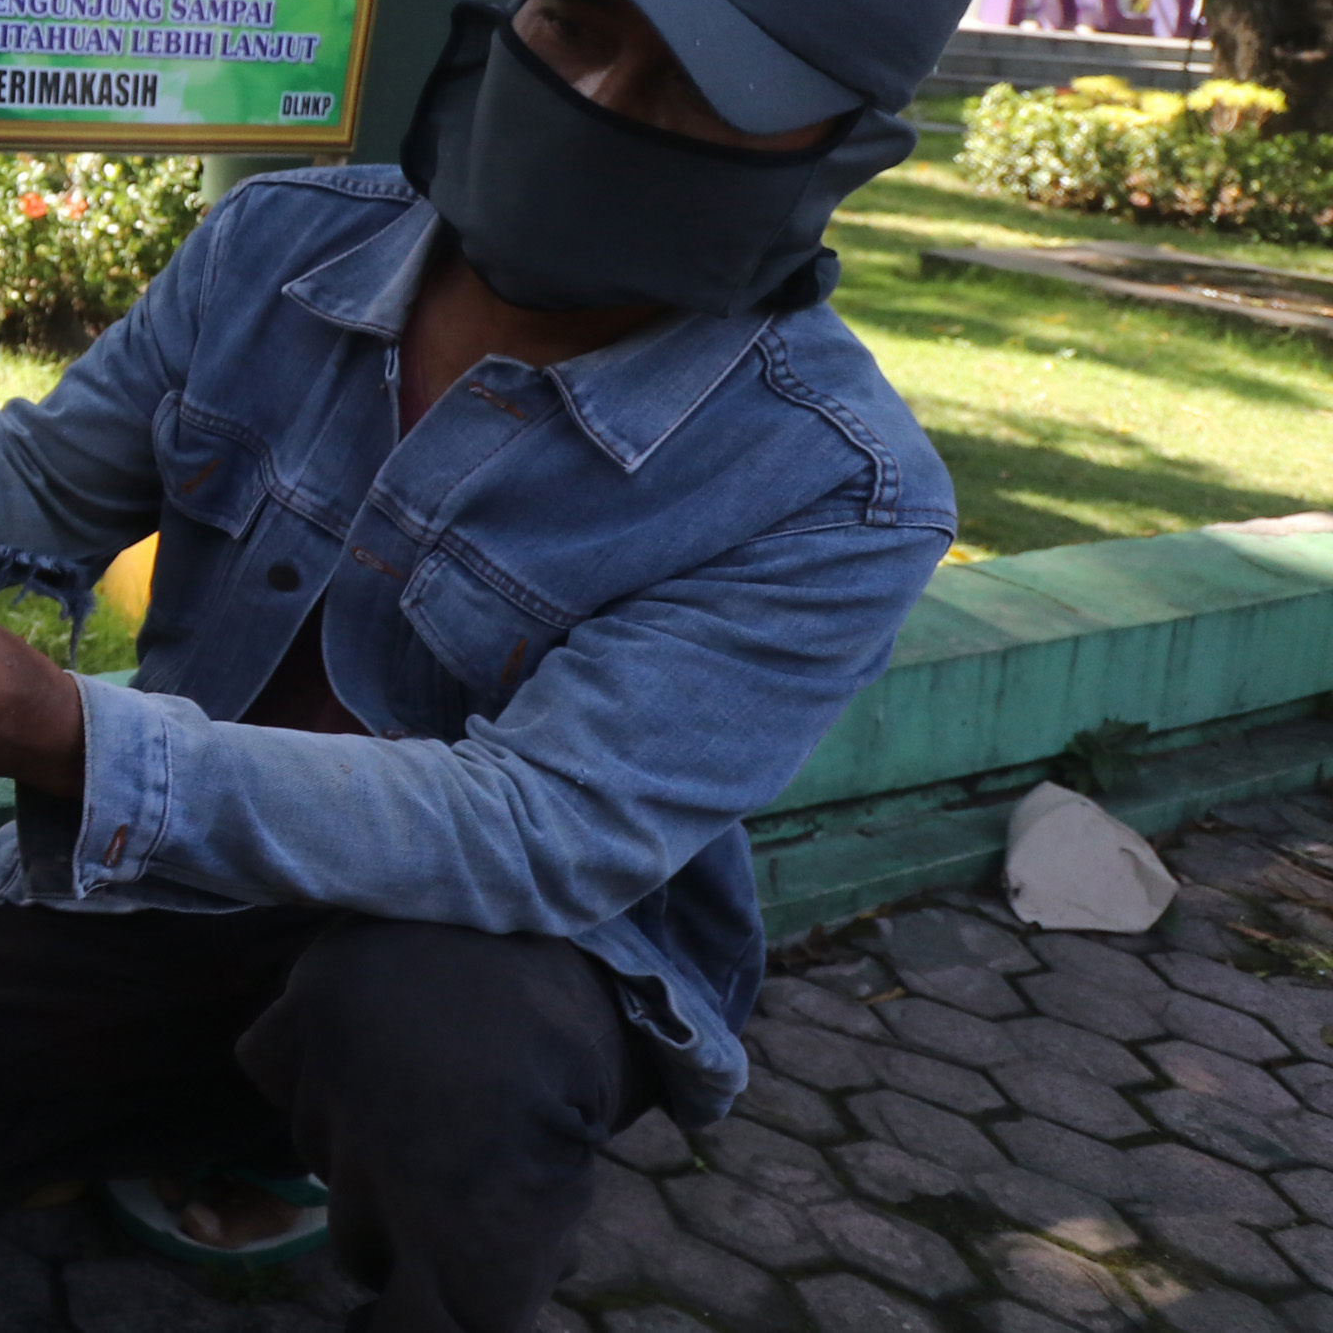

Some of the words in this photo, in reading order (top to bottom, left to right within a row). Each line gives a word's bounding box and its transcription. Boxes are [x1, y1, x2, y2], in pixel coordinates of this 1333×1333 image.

[131, 29, 212, 57] LEBIH
[221, 33, 318, 61] LANJUT
[281, 94, 332, 118] DLHKP
